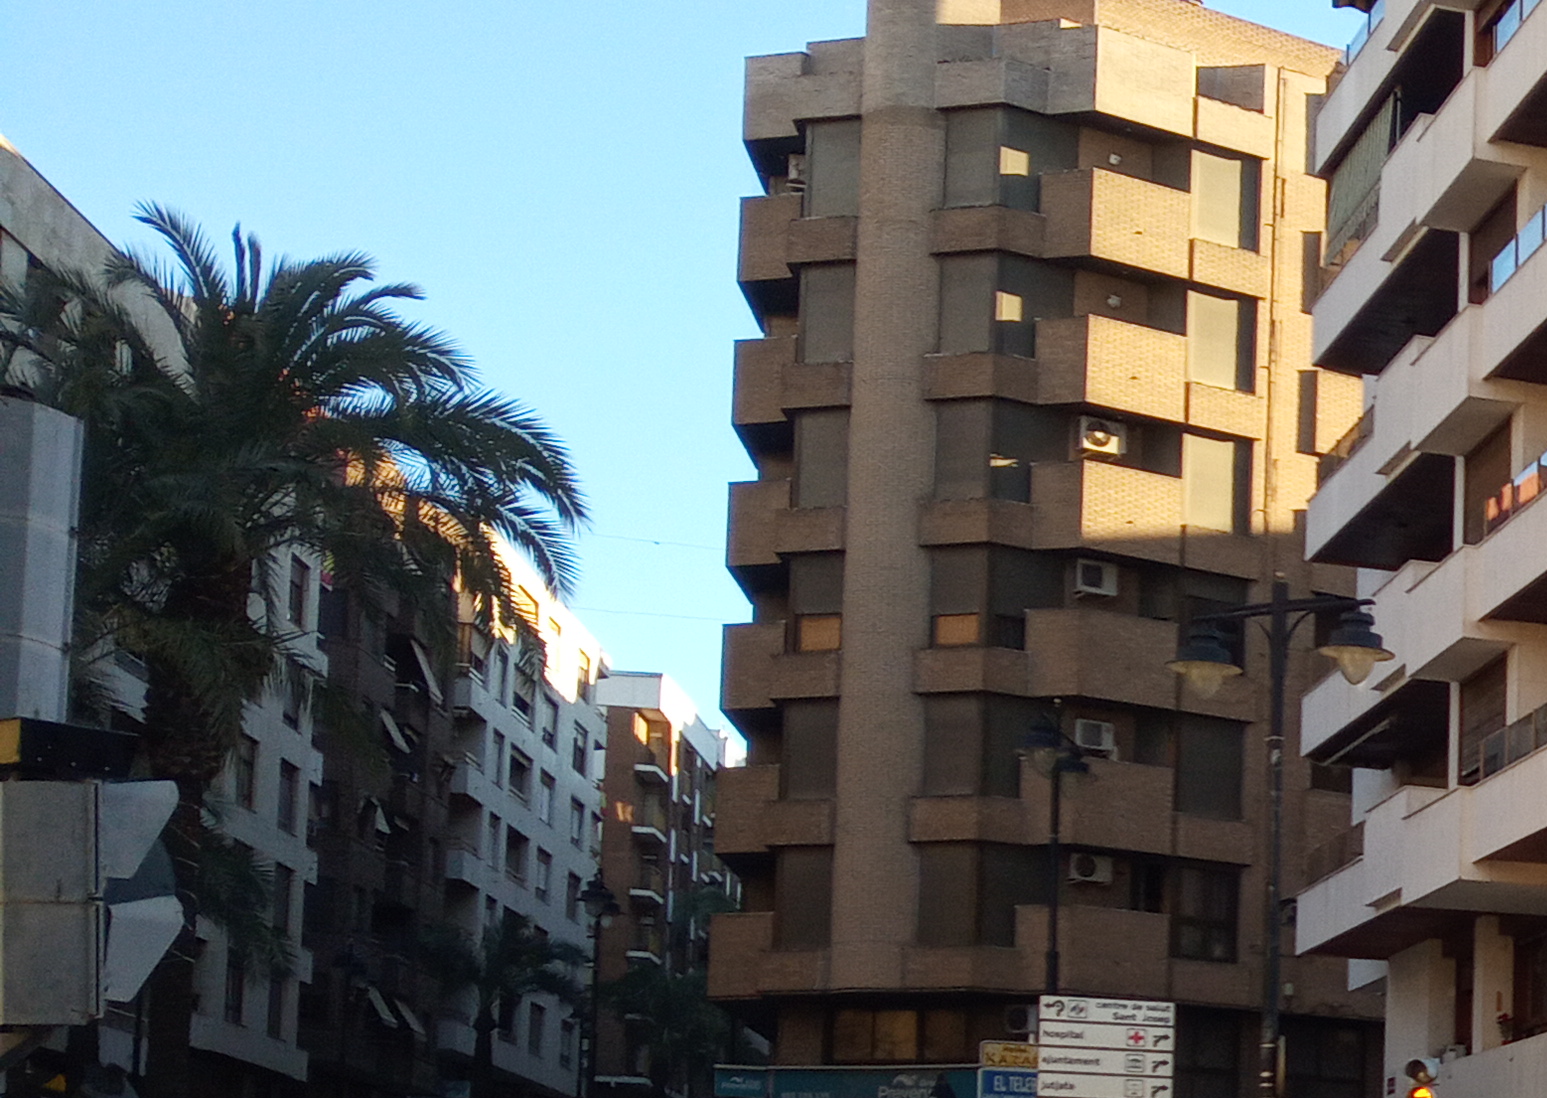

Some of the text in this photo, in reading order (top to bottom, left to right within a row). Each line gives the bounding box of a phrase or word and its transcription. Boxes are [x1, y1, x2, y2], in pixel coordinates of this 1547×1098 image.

[1112, 1012, 1137, 1021] Sant
[1042, 1029, 1084, 1040] hospital
[1041, 1055, 1101, 1066] ajuntament
